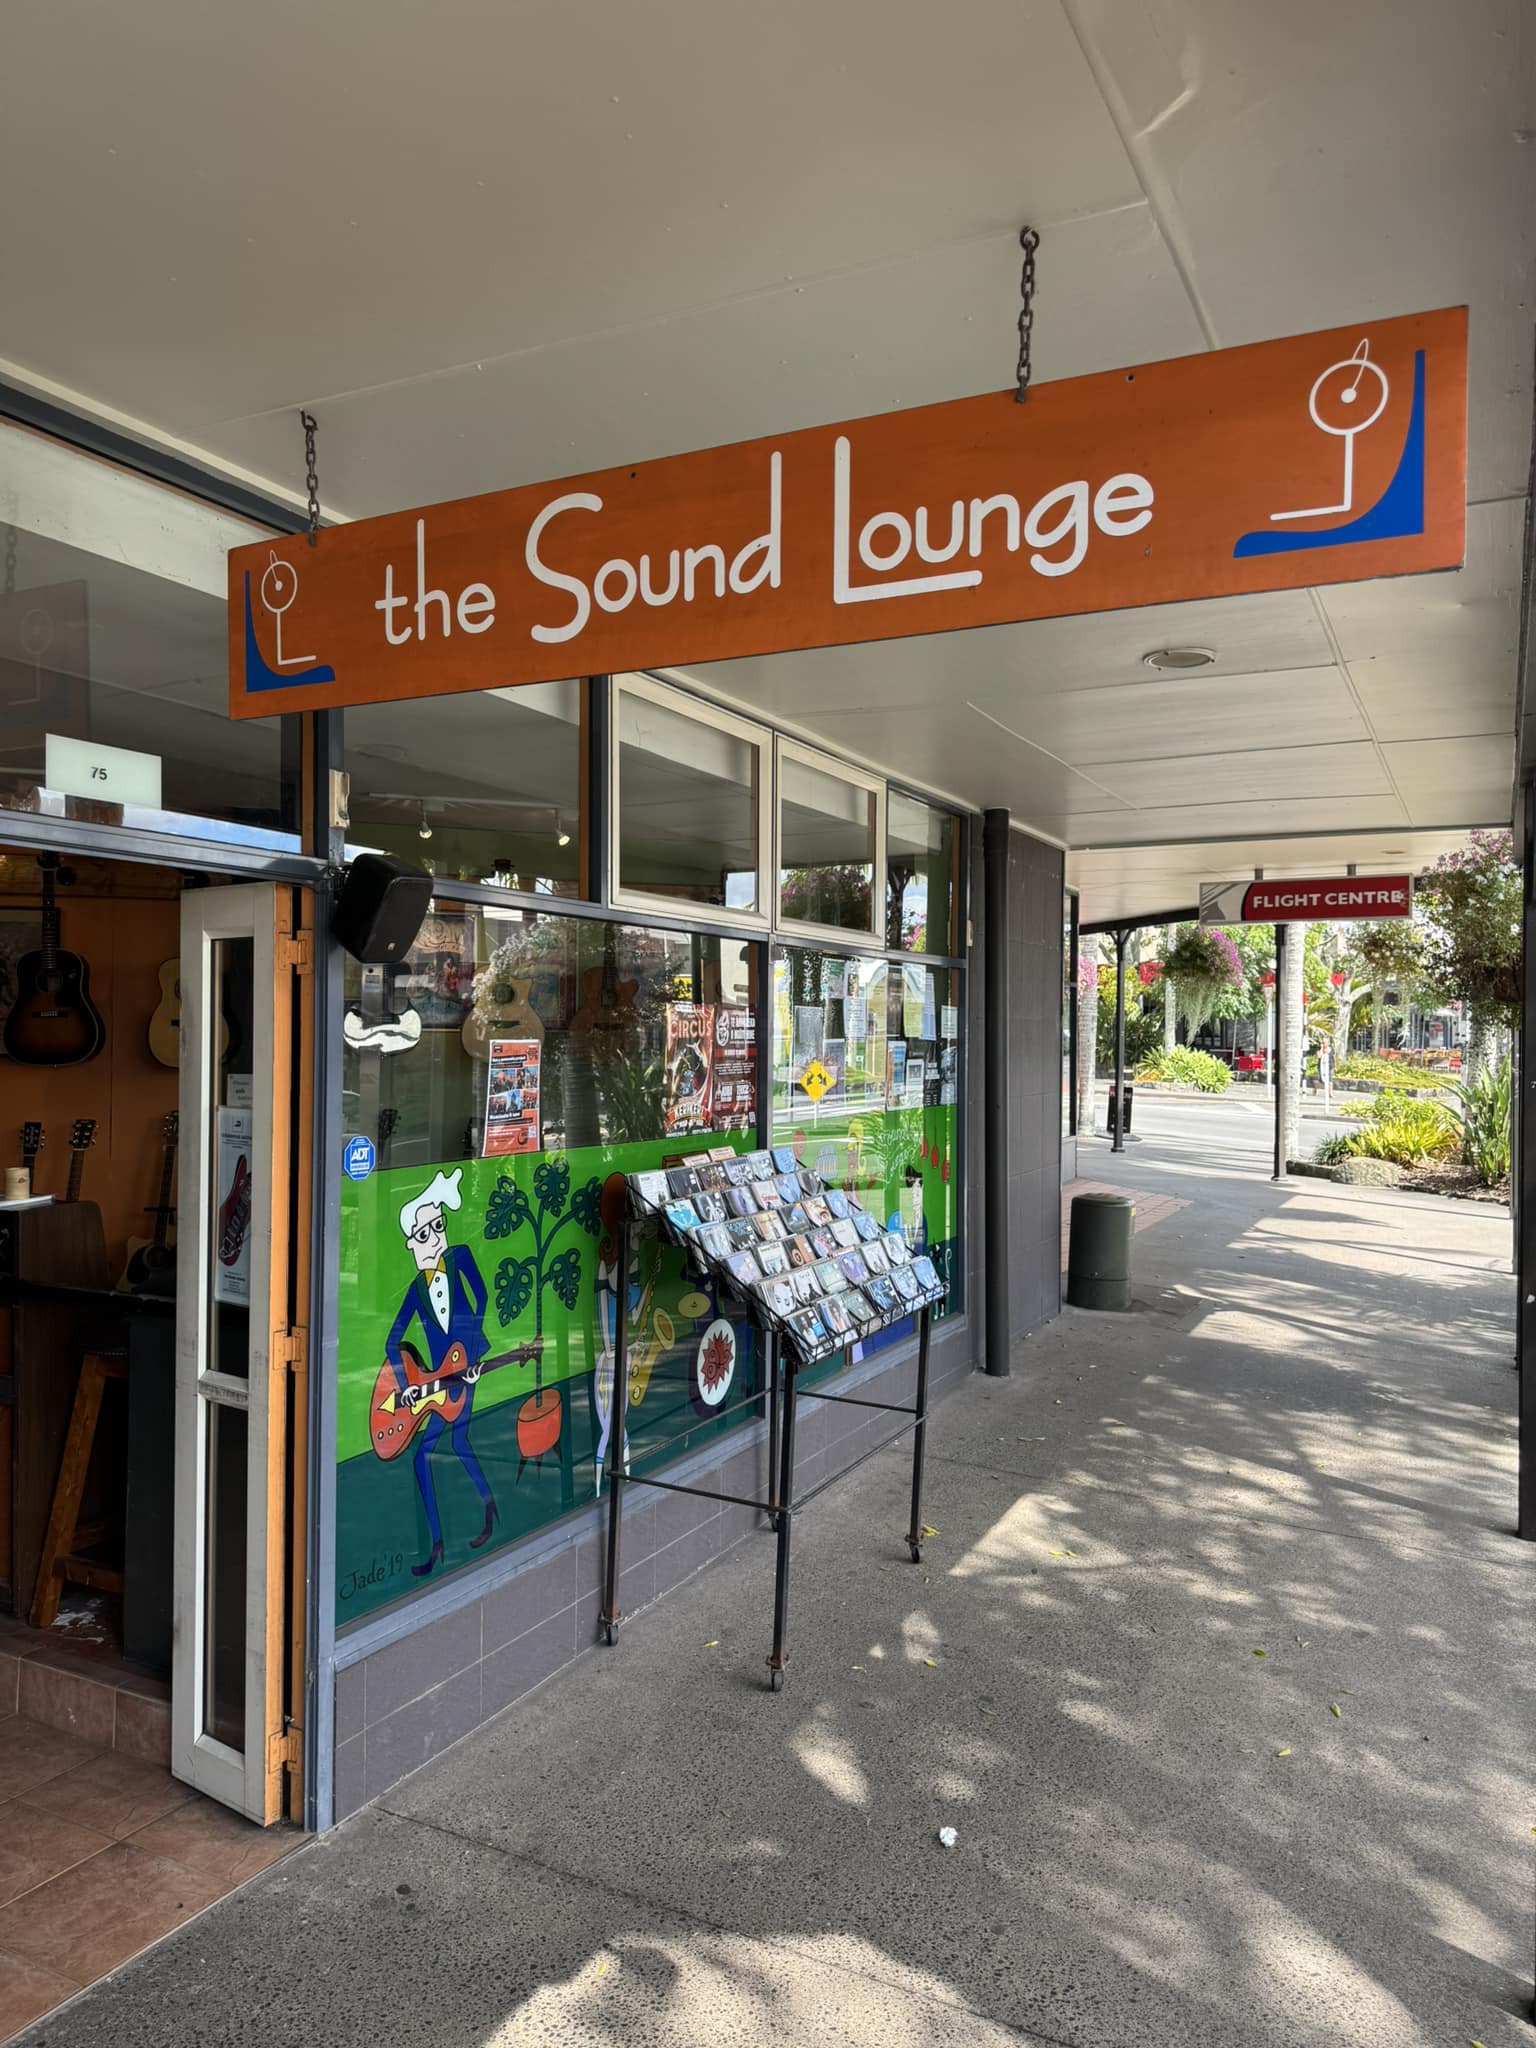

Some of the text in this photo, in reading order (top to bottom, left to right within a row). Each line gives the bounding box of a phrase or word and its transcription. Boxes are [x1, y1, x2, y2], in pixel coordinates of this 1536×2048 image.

[375, 435, 1154, 645] the Sound Lounge
[90, 766, 108, 781] 75
[1253, 890, 1404, 908] FLIGHT CENTRE
[671, 1020, 713, 1038] CIRCUS
[351, 1147, 370, 1161] ADT
[339, 1558, 386, 1600] Jade
